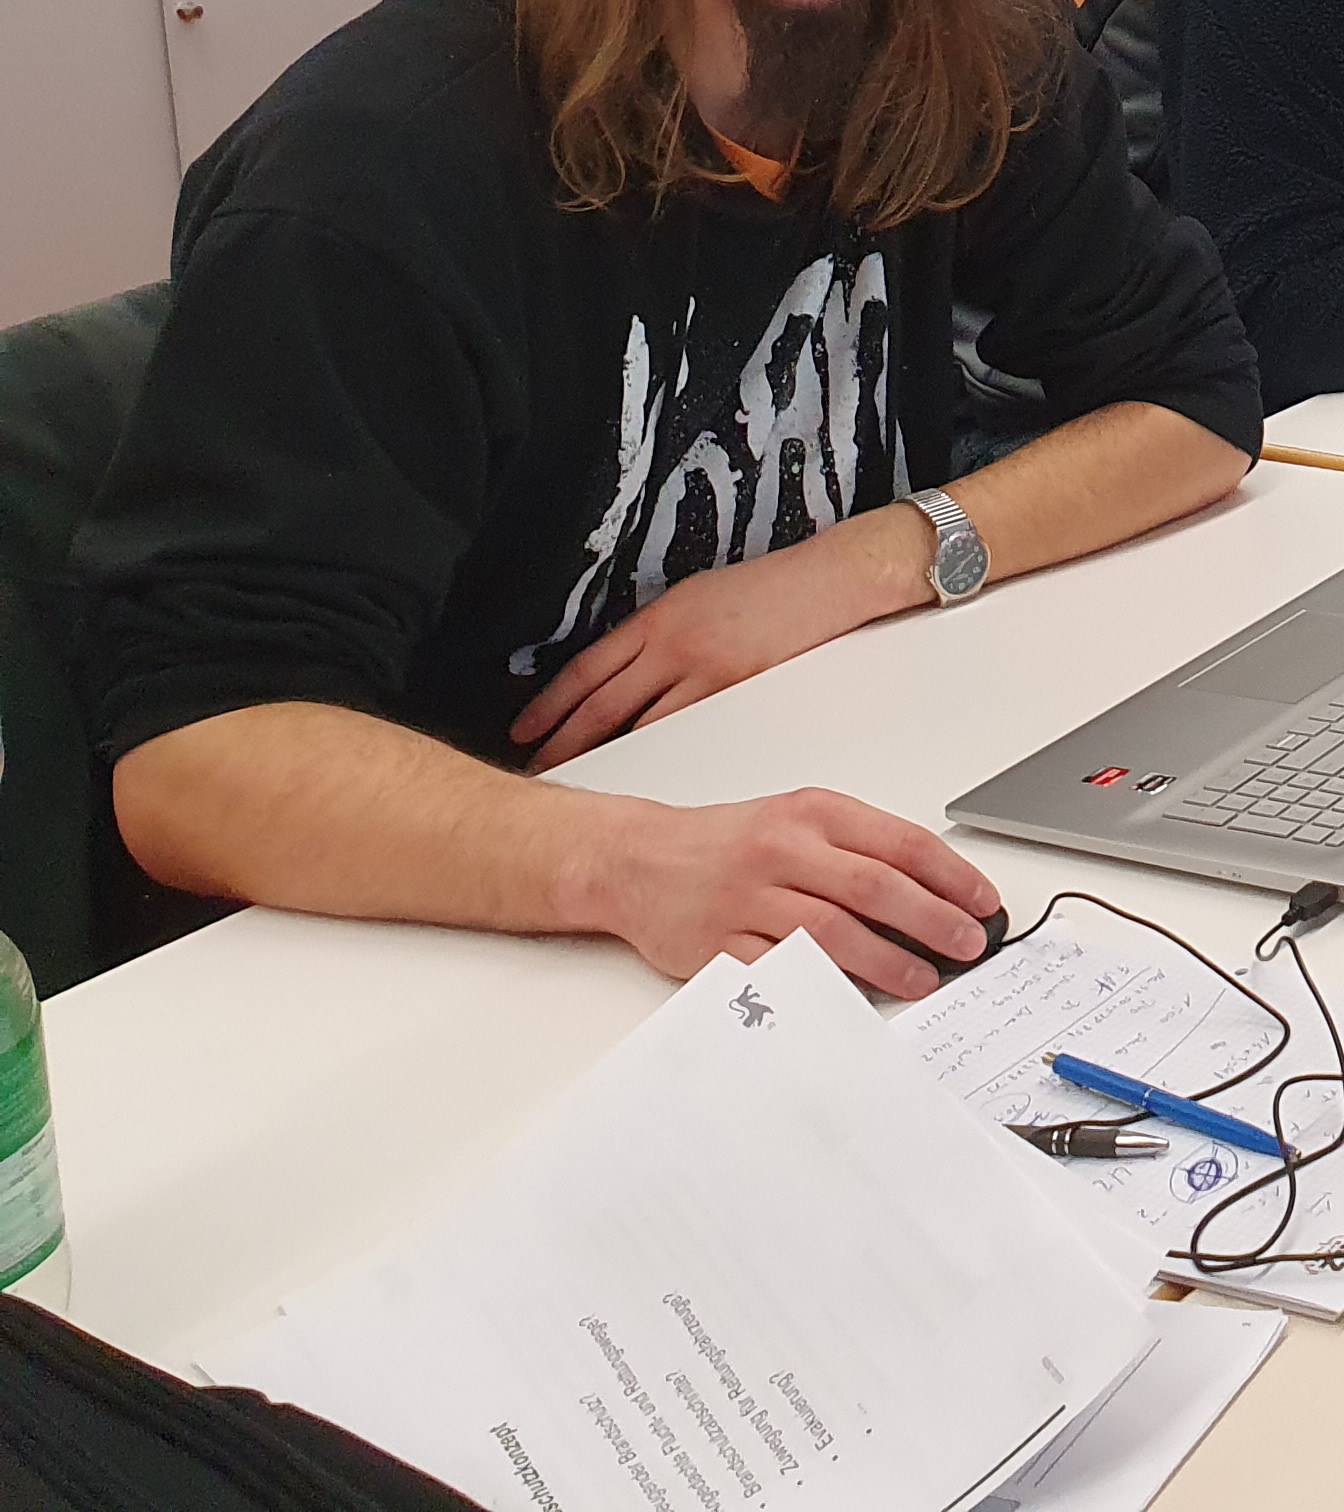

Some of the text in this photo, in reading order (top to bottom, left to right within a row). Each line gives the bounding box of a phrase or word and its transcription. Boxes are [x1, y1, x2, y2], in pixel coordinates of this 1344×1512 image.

[579, 1314, 641, 1397] Rettungswege?
[662, 1291, 799, 1476] Zuwegung für Rettungsfahrzeuge?
[630, 1392, 656, 1416] und
[666, 1369, 762, 1498] Brandschutzabschnitte?
[769, 1370, 834, 1452] Evakuierung?
[490, 1422, 563, 1512] schutzkonzept
[579, 1393, 675, 1512] eugender Brandschutz?
